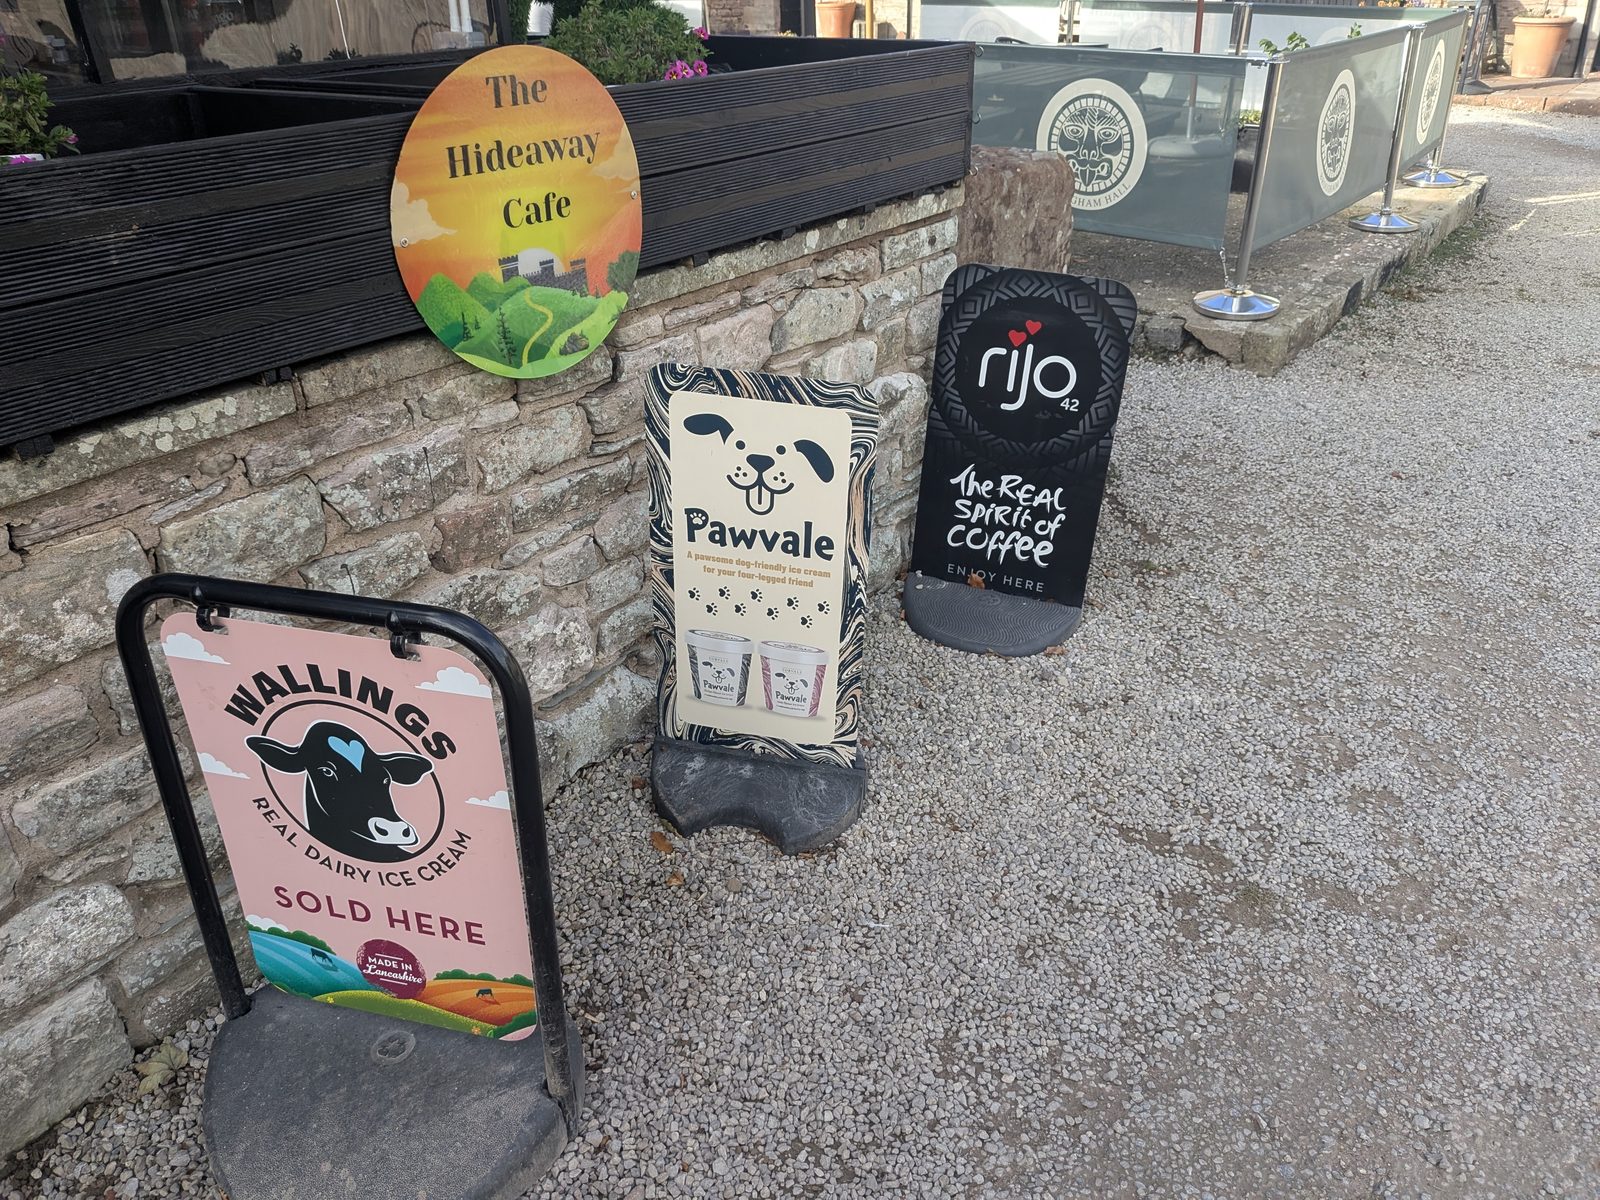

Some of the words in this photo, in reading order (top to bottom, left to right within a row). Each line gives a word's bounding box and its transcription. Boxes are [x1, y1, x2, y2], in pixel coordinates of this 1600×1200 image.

[486, 74, 548, 109] The
[446, 132, 600, 179] Hideaway
[1104, 182, 1131, 204] HALL
[503, 191, 571, 229] Cafe
[1060, 397, 1080, 412] 42
[949, 463, 994, 498] The
[684, 507, 835, 562] Pawvale
[1034, 513, 1066, 540] of
[686, 551, 693, 559] A
[694, 552, 734, 565] pawsome
[735, 558, 787, 574] dog-friendly
[789, 564, 801, 574] ice
[803, 569, 831, 578] cream
[703, 565, 715, 574] for
[717, 568, 736, 579] your
[737, 570, 787, 584] four-legged
[788, 577, 814, 588] friend
[1003, 575, 1045, 593] HERE
[703, 679, 735, 693] Pawvale
[775, 690, 808, 704] Pawvale
[223, 663, 457, 760] WALLINGS
[251, 796, 299, 848] REAL
[304, 844, 372, 883] DAIRY
[377, 870, 417, 887] ICE
[417, 829, 472, 882] CREAM
[274, 885, 372, 923] SOLD
[385, 906, 486, 945] HERE
[362, 963, 423, 984] Lancashire
[368, 956, 400, 970] MADE
[401, 962, 413, 971] IN
